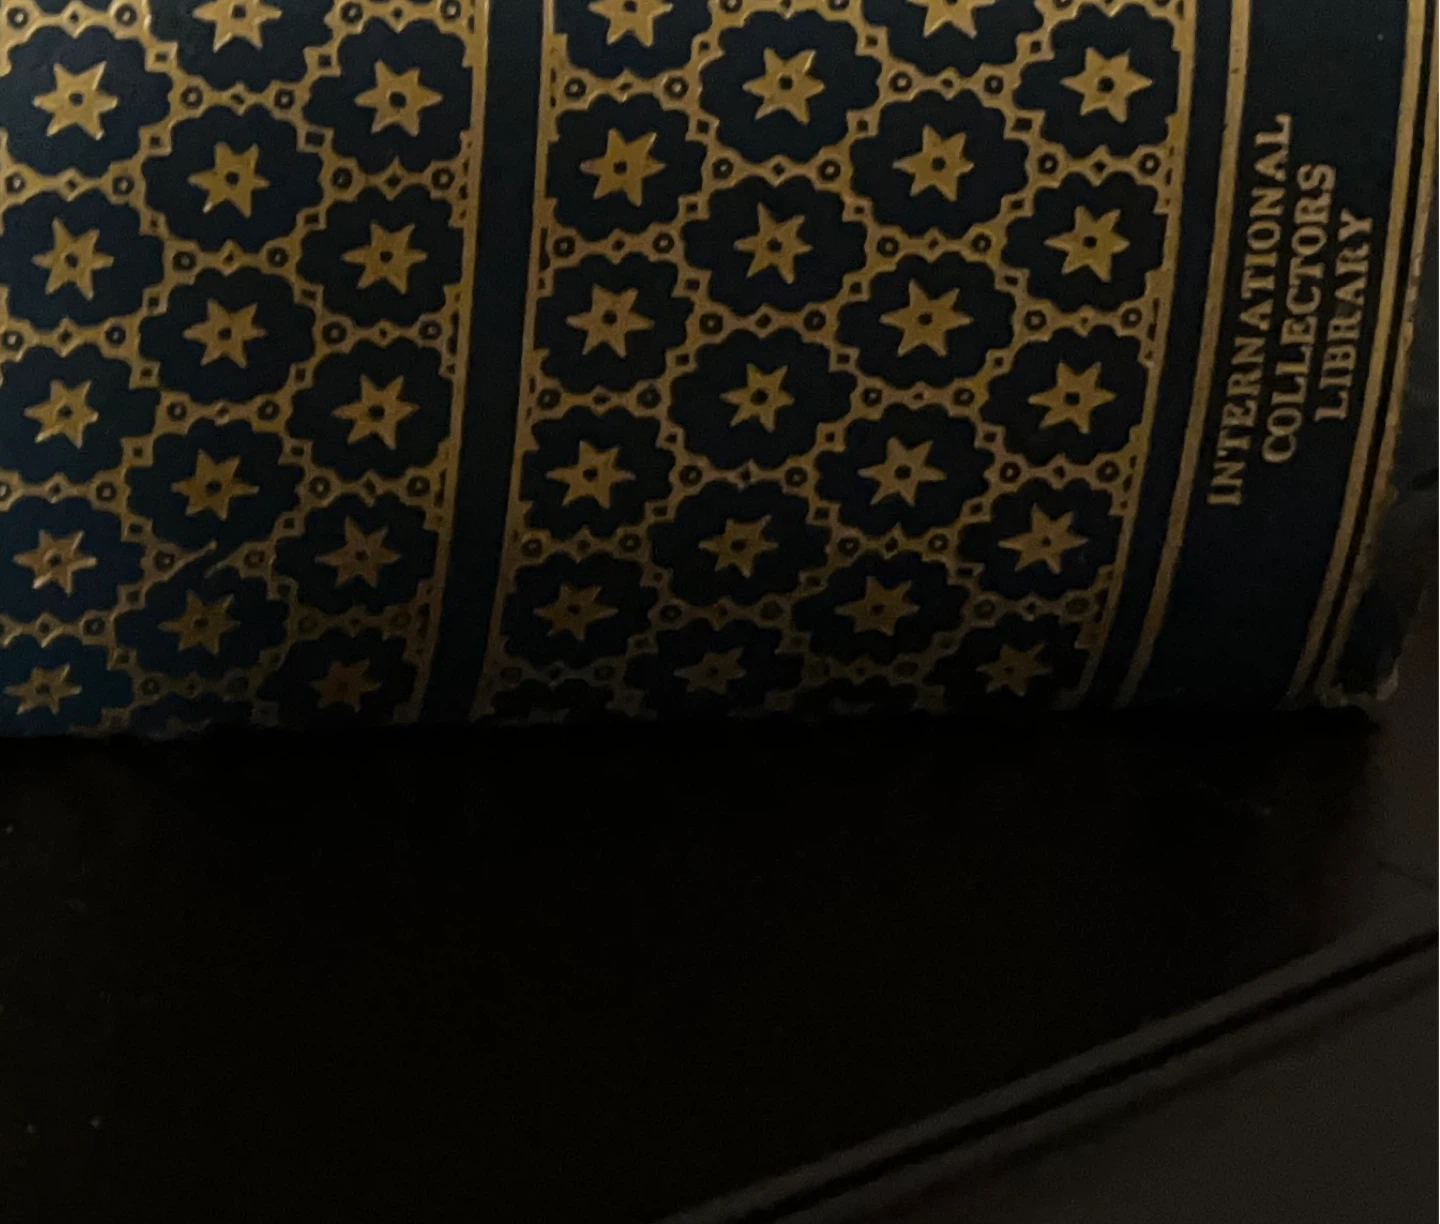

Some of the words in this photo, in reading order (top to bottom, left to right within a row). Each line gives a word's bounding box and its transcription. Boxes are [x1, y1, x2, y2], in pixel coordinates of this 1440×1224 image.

[1206, 112, 1294, 508] INTERNATIONAL
[1260, 162, 1338, 465] COLLECTORS
[1314, 207, 1376, 423] LIBRARY
